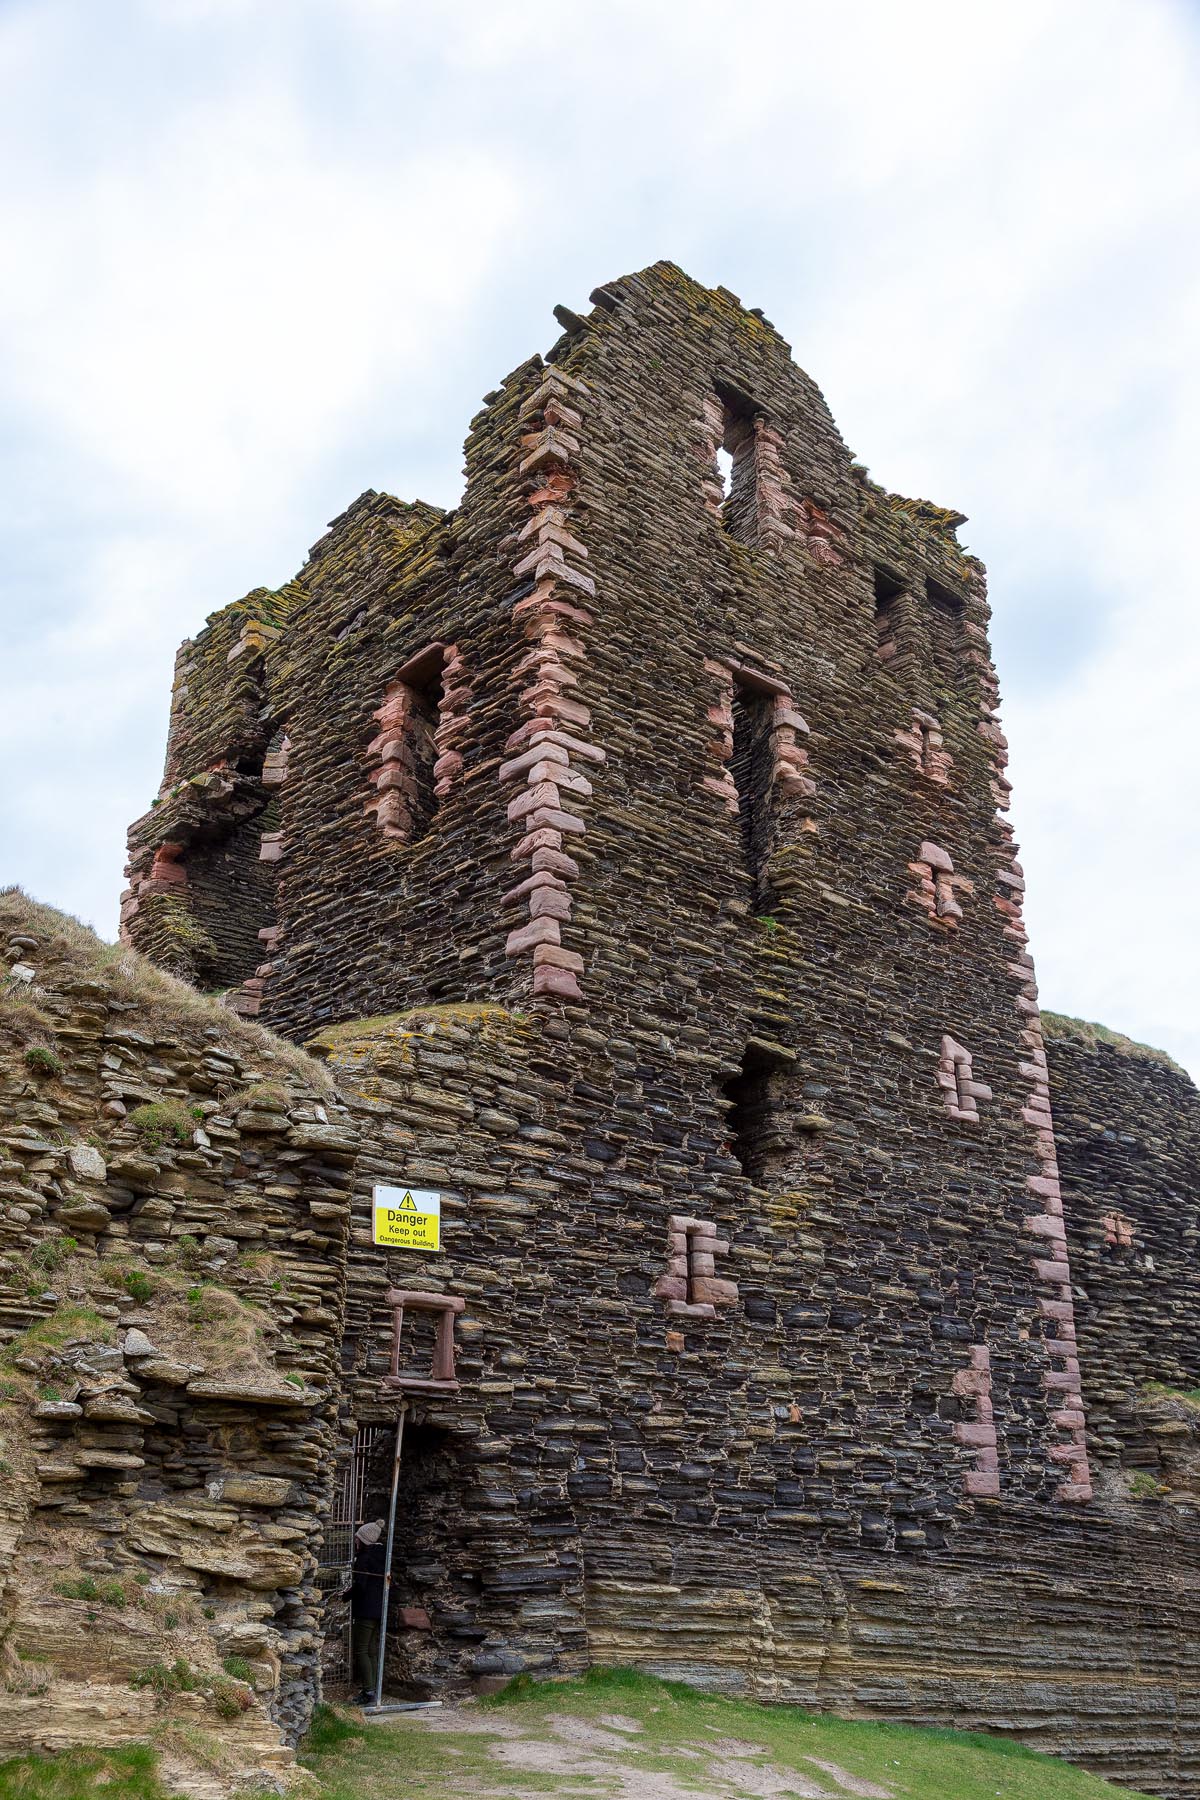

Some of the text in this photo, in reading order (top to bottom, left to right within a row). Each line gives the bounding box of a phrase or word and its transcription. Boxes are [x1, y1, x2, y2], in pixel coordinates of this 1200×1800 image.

[388, 1210, 428, 1226] Danger
[388, 1225, 410, 1236] Keep
[380, 1235, 434, 1248] Dangerous Building
